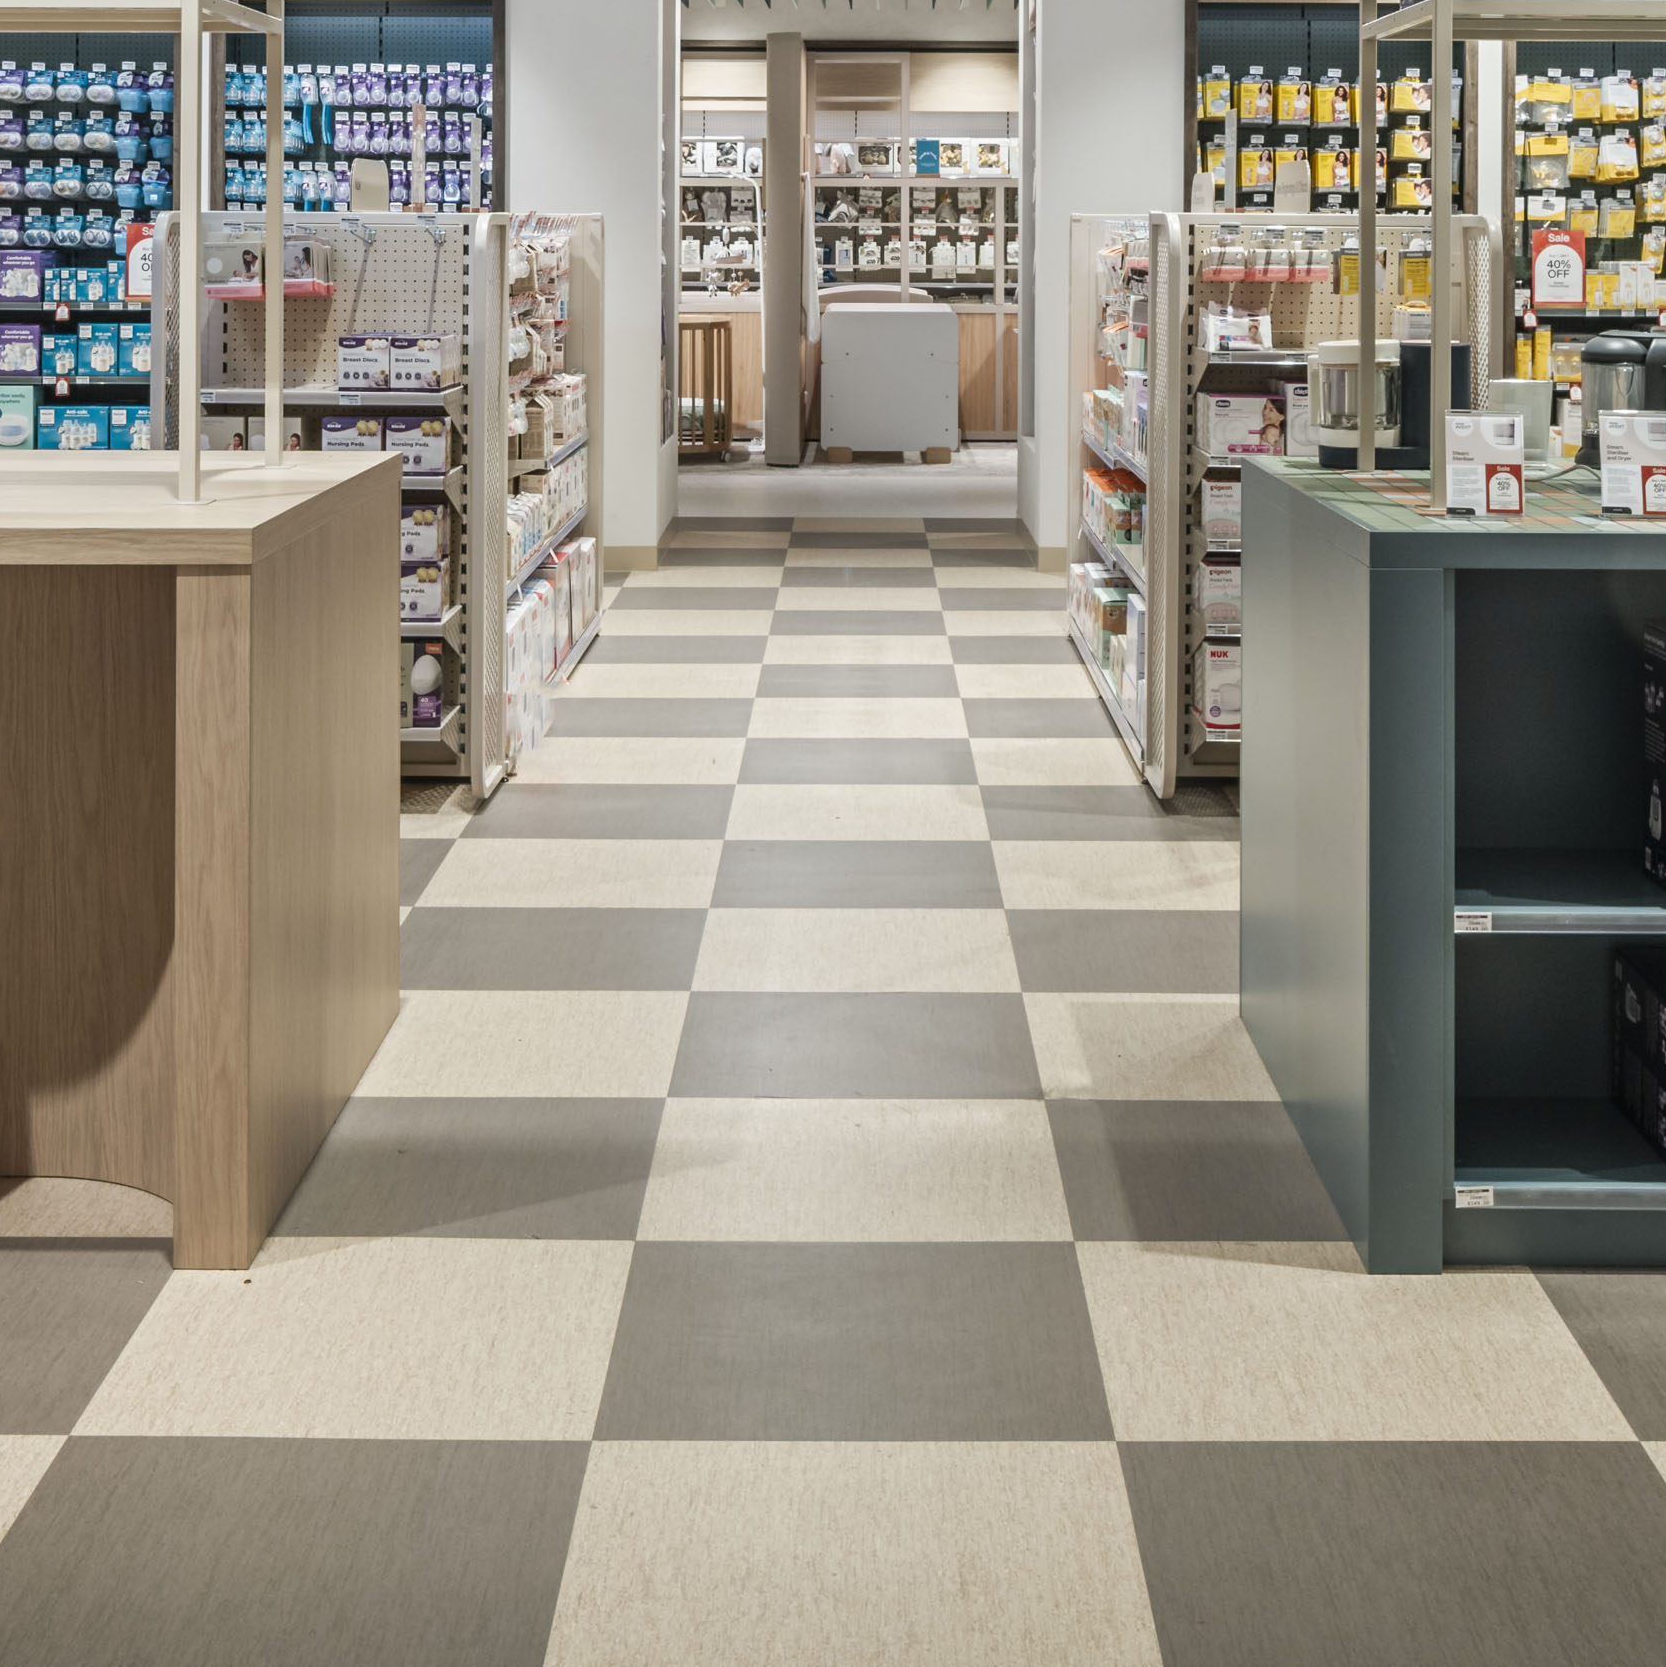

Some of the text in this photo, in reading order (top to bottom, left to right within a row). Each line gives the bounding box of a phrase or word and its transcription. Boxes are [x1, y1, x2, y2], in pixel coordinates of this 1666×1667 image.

[1548, 234, 1570, 242] Sale
[1547, 260, 1571, 269] 40%
[1548, 270, 1570, 278] OFF
[1210, 650, 1228, 658] NUK
